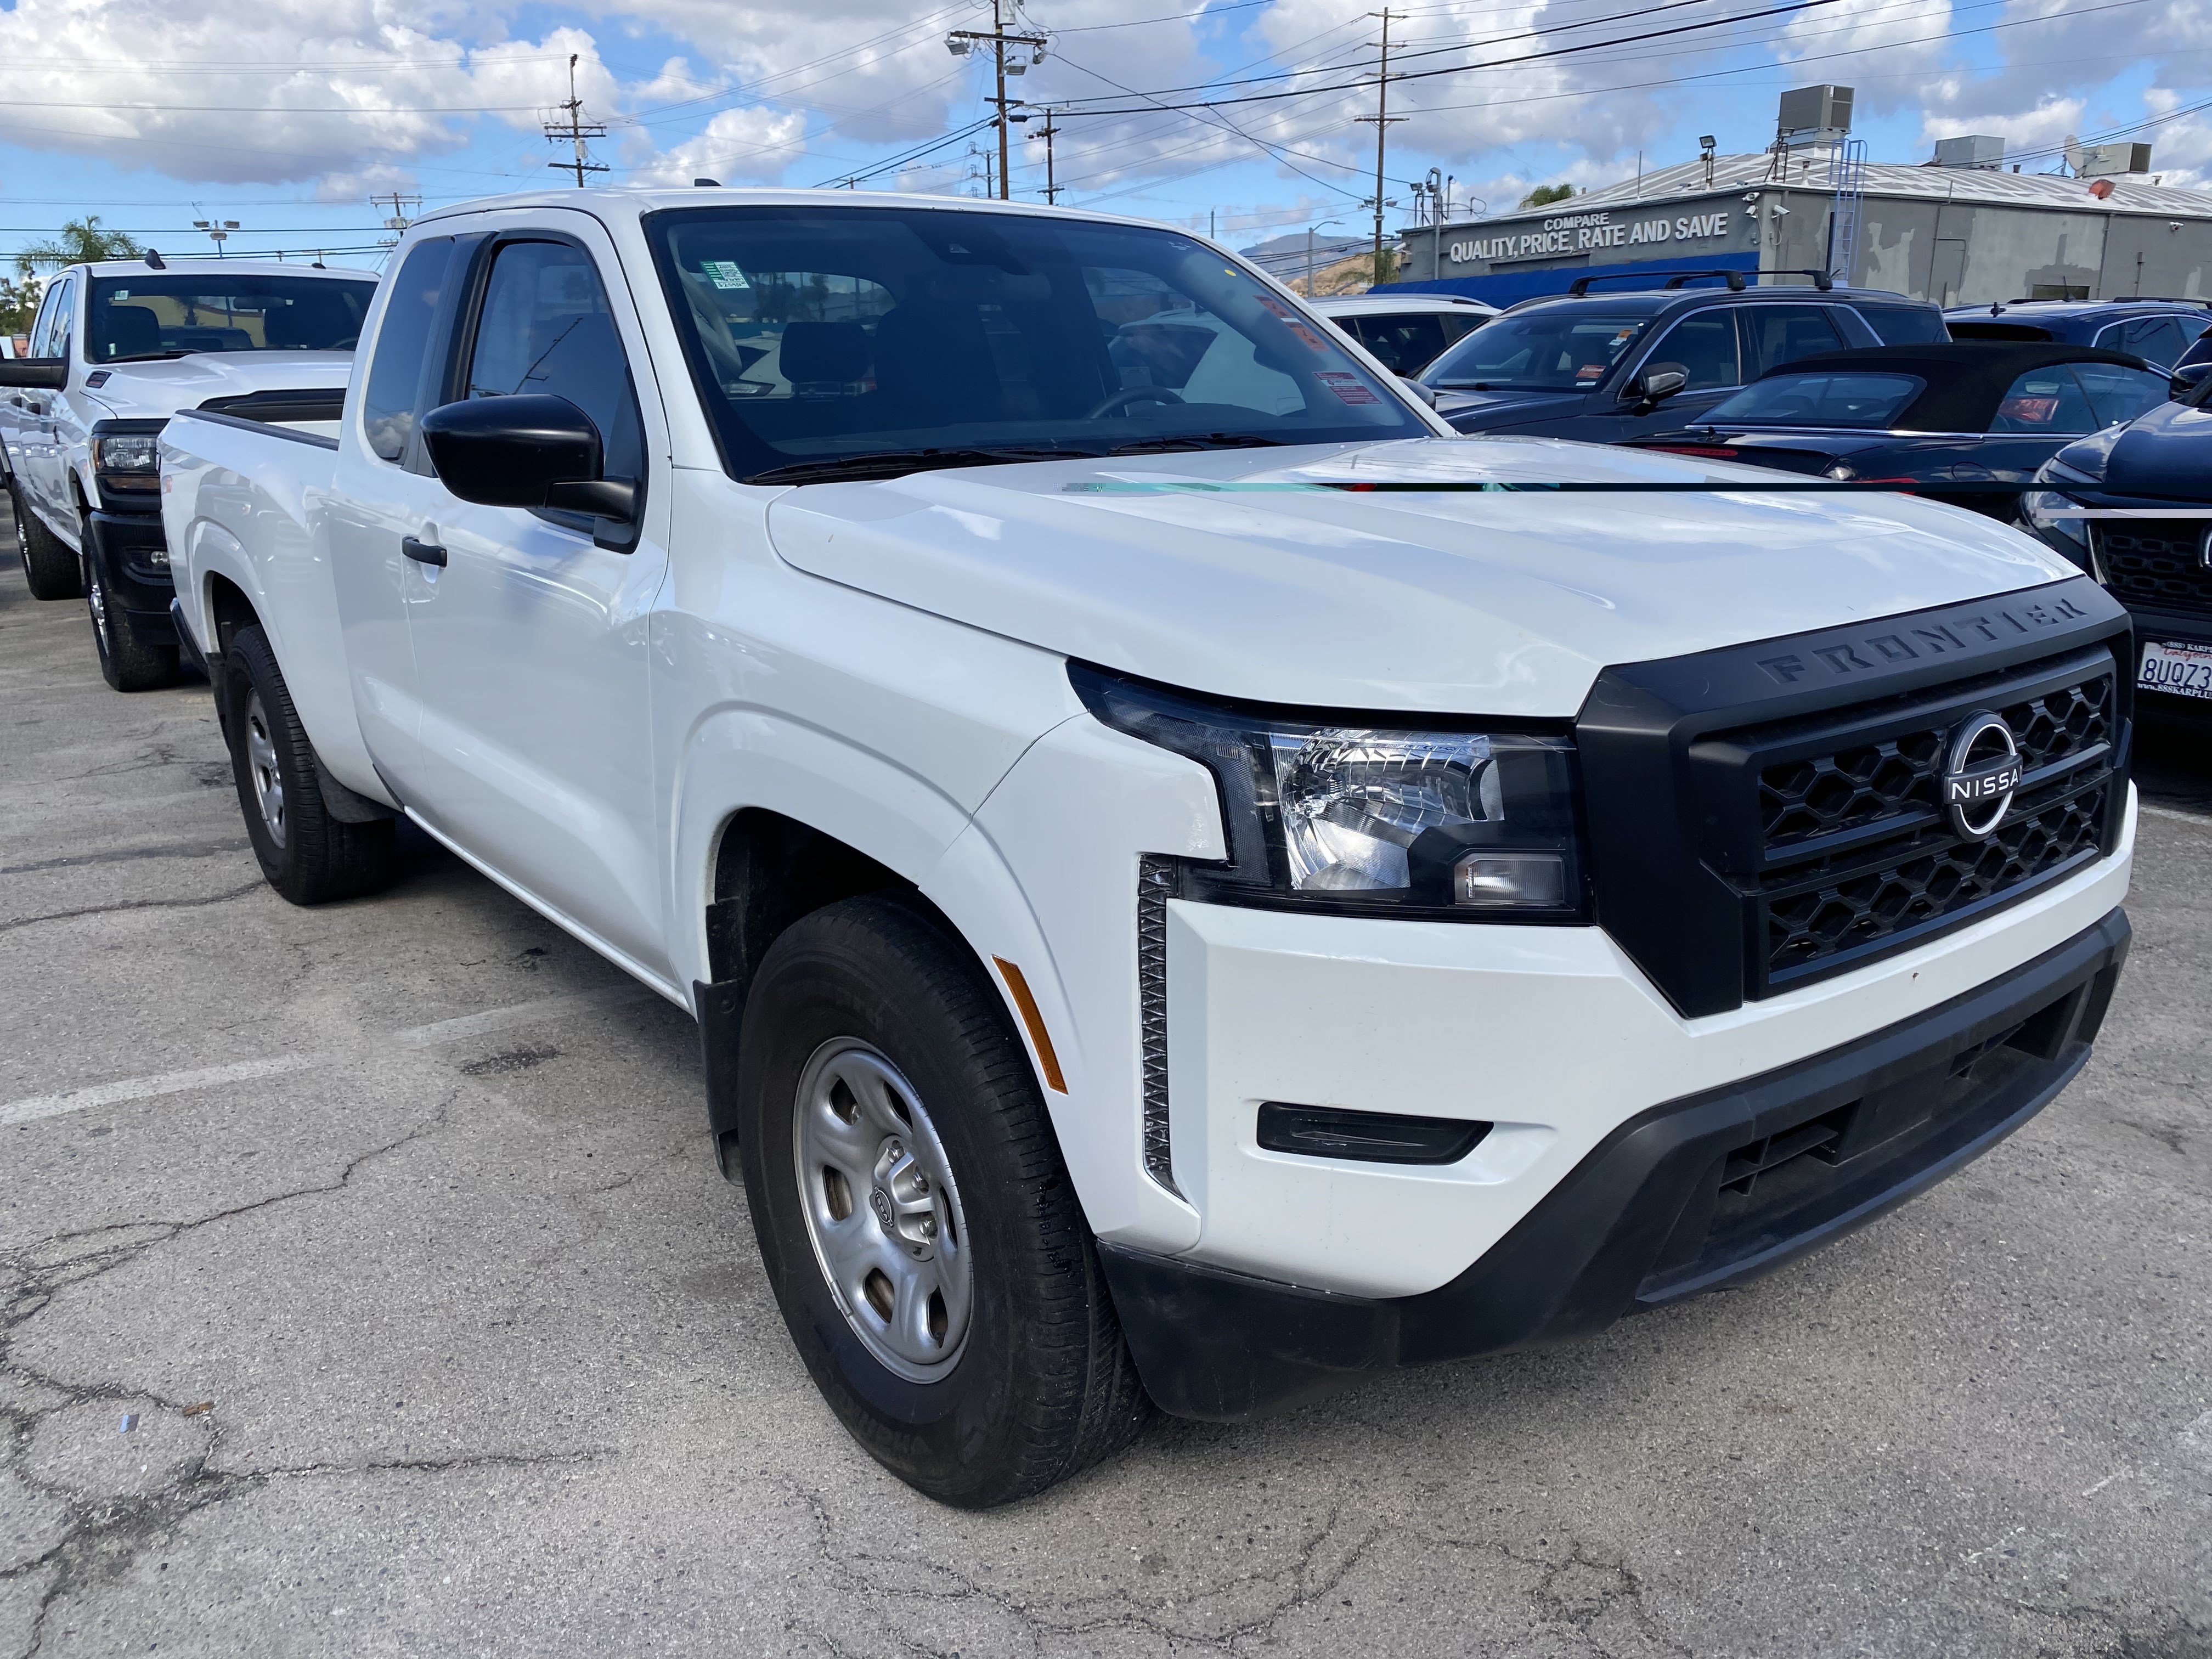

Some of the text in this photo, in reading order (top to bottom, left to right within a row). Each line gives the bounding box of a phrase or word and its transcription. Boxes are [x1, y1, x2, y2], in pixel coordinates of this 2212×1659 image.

[1450, 212, 1729, 263] QUALITY, PRICE, RATE AND SAVE
[1544, 212, 1610, 232] COMPARE
[1755, 598, 2088, 685] FRONTIER
[874, 1186, 894, 1228] NISSAN
